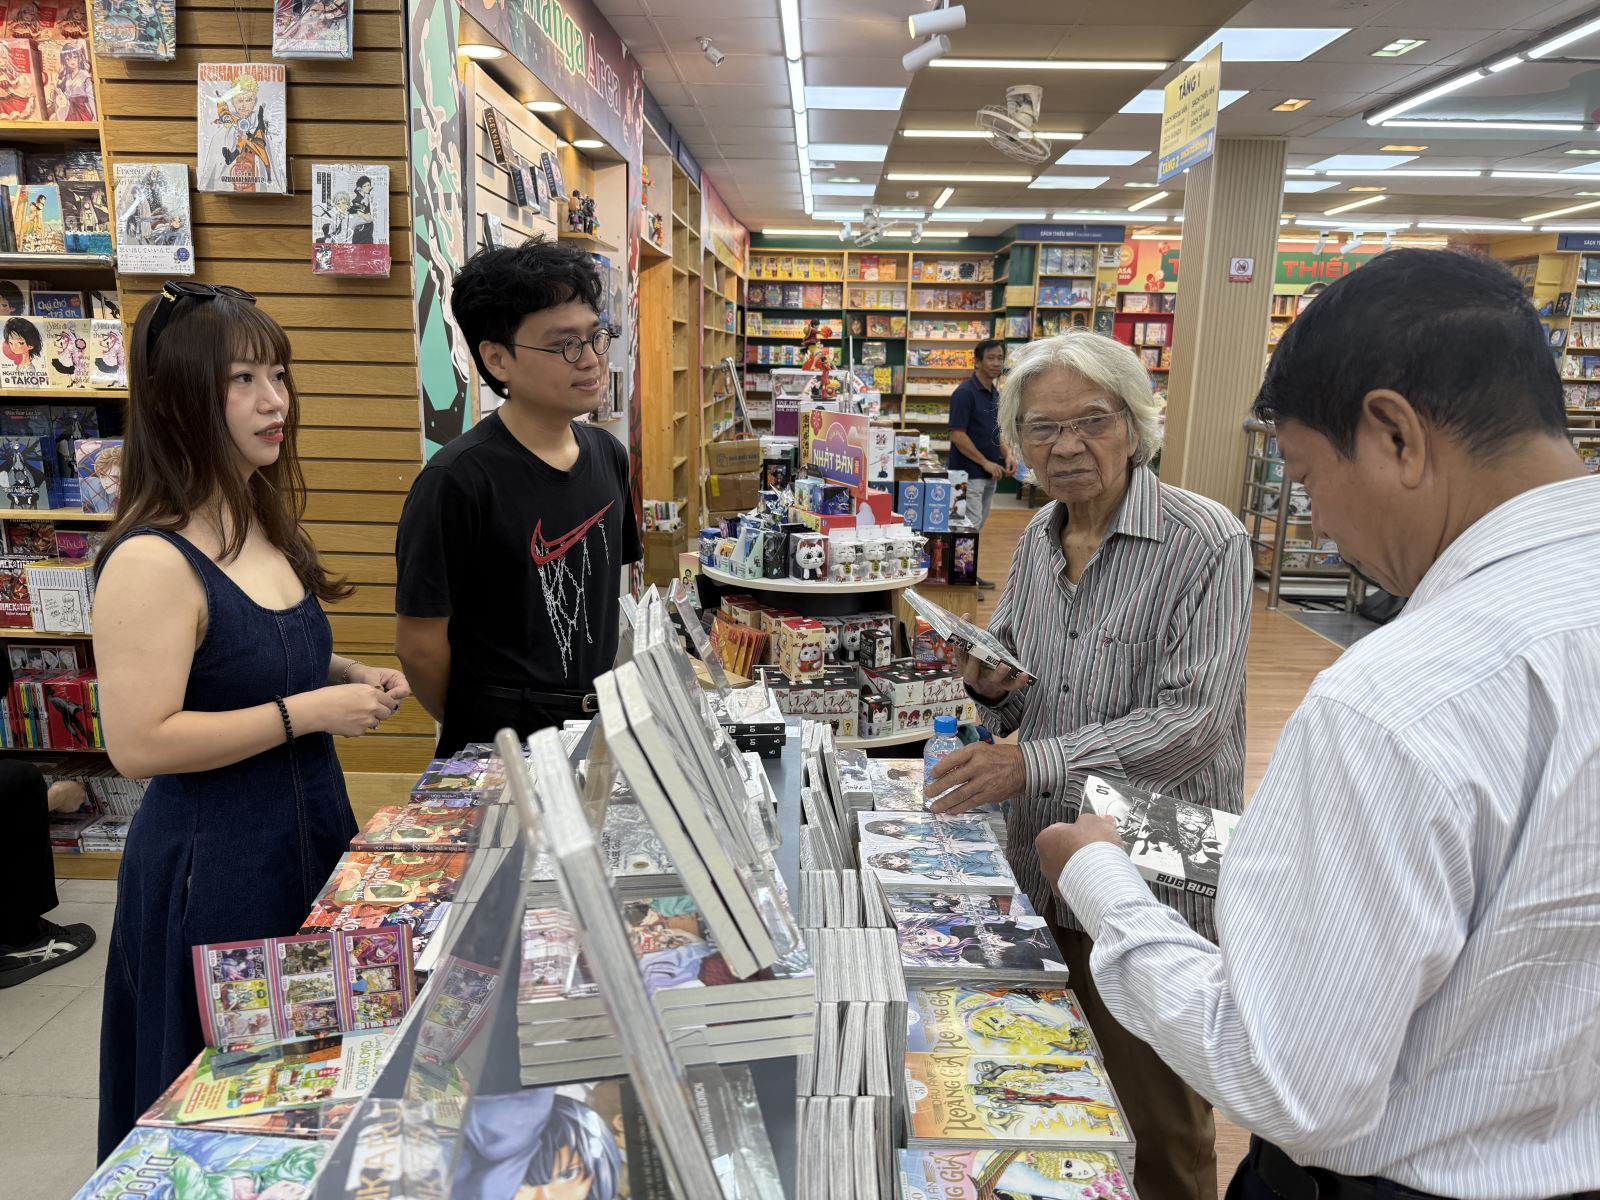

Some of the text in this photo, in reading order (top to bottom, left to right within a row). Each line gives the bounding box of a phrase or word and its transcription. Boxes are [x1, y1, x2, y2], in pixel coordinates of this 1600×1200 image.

[586, 31, 622, 118] Area
[487, 117, 503, 157] GENSHIN
[813, 446, 835, 472] NHẬT
[835, 450, 854, 476] BẢN
[1156, 873, 1216, 897] BUG BUG
[930, 1053, 969, 1079] GIA
[943, 1078, 985, 1136] HOÀNG
[928, 1151, 973, 1185] GIA
